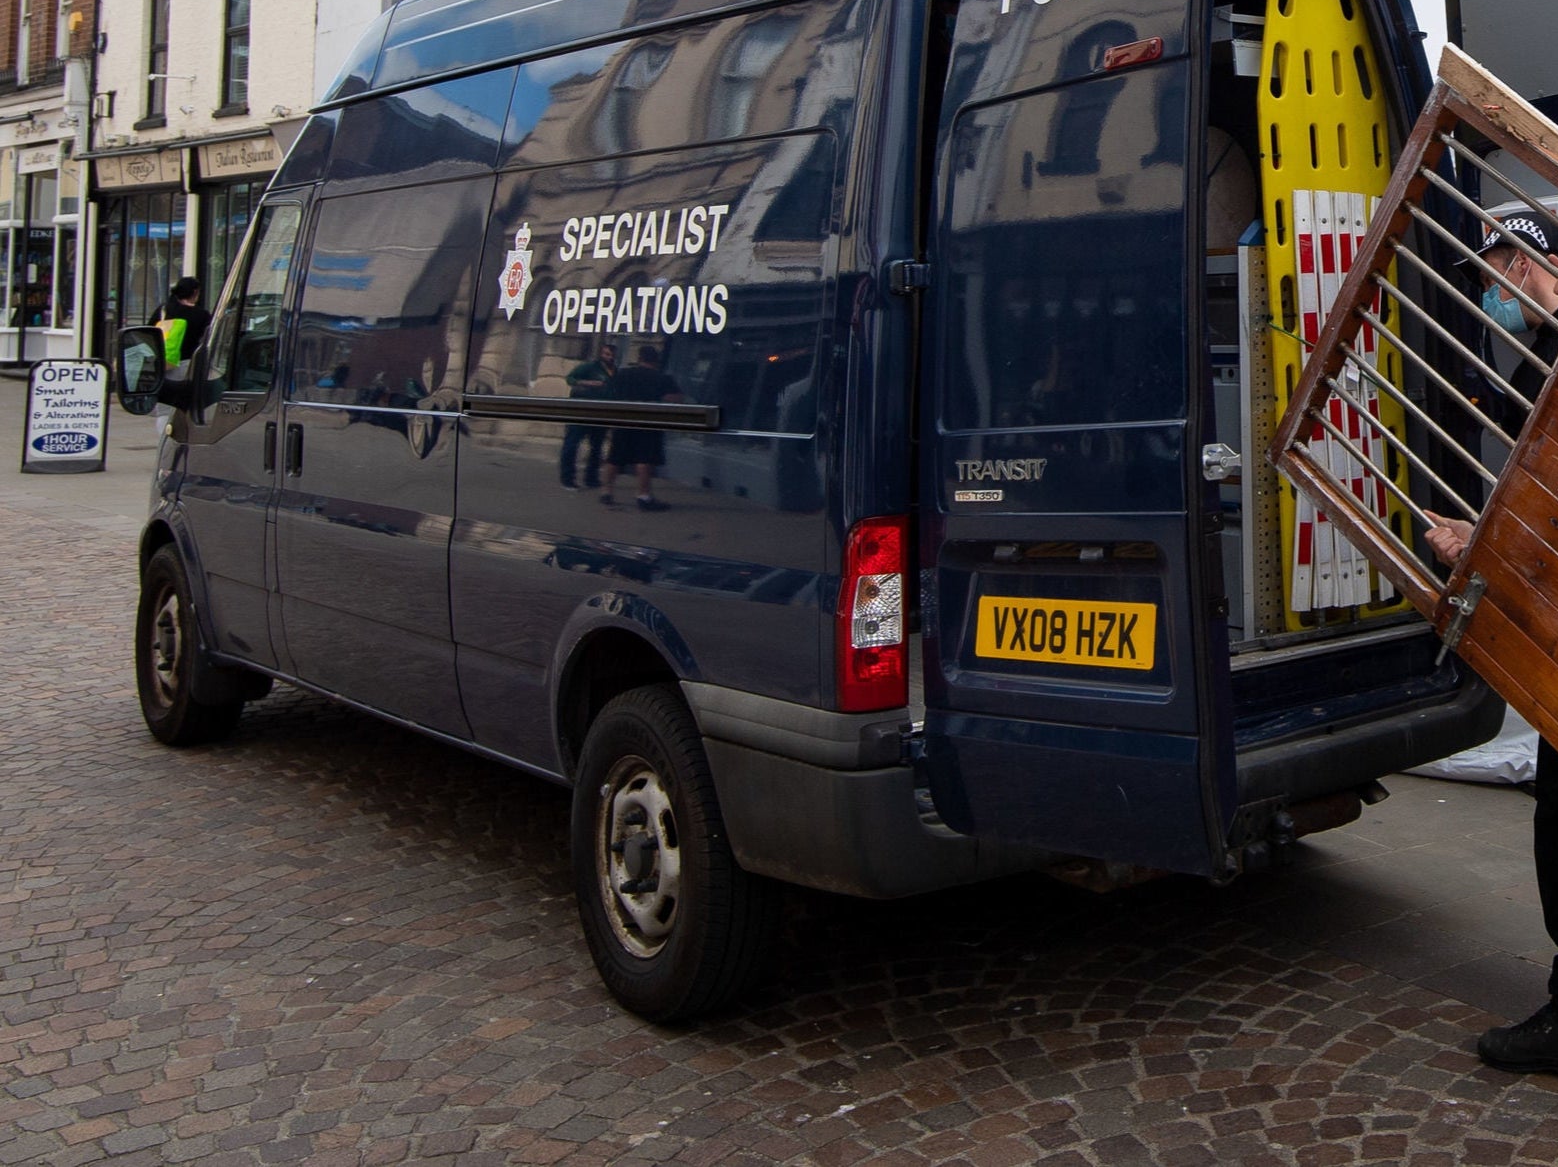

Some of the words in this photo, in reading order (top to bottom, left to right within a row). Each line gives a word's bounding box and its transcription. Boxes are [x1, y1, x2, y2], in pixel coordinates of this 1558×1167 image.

[560, 204, 729, 262] SPECIALIST
[543, 284, 729, 334] OPERATIONS
[42, 368, 98, 382] OPEN
[35, 386, 75, 395] Smart
[43, 398, 100, 409] Tailoring
[32, 422, 62, 430] LADIES
[41, 443, 88, 452] SERVICE
[955, 458, 1047, 482] TRANSIT
[972, 491, 1000, 500] T350
[994, 606, 1068, 654] VX08
[1076, 611, 1138, 659] HZK
